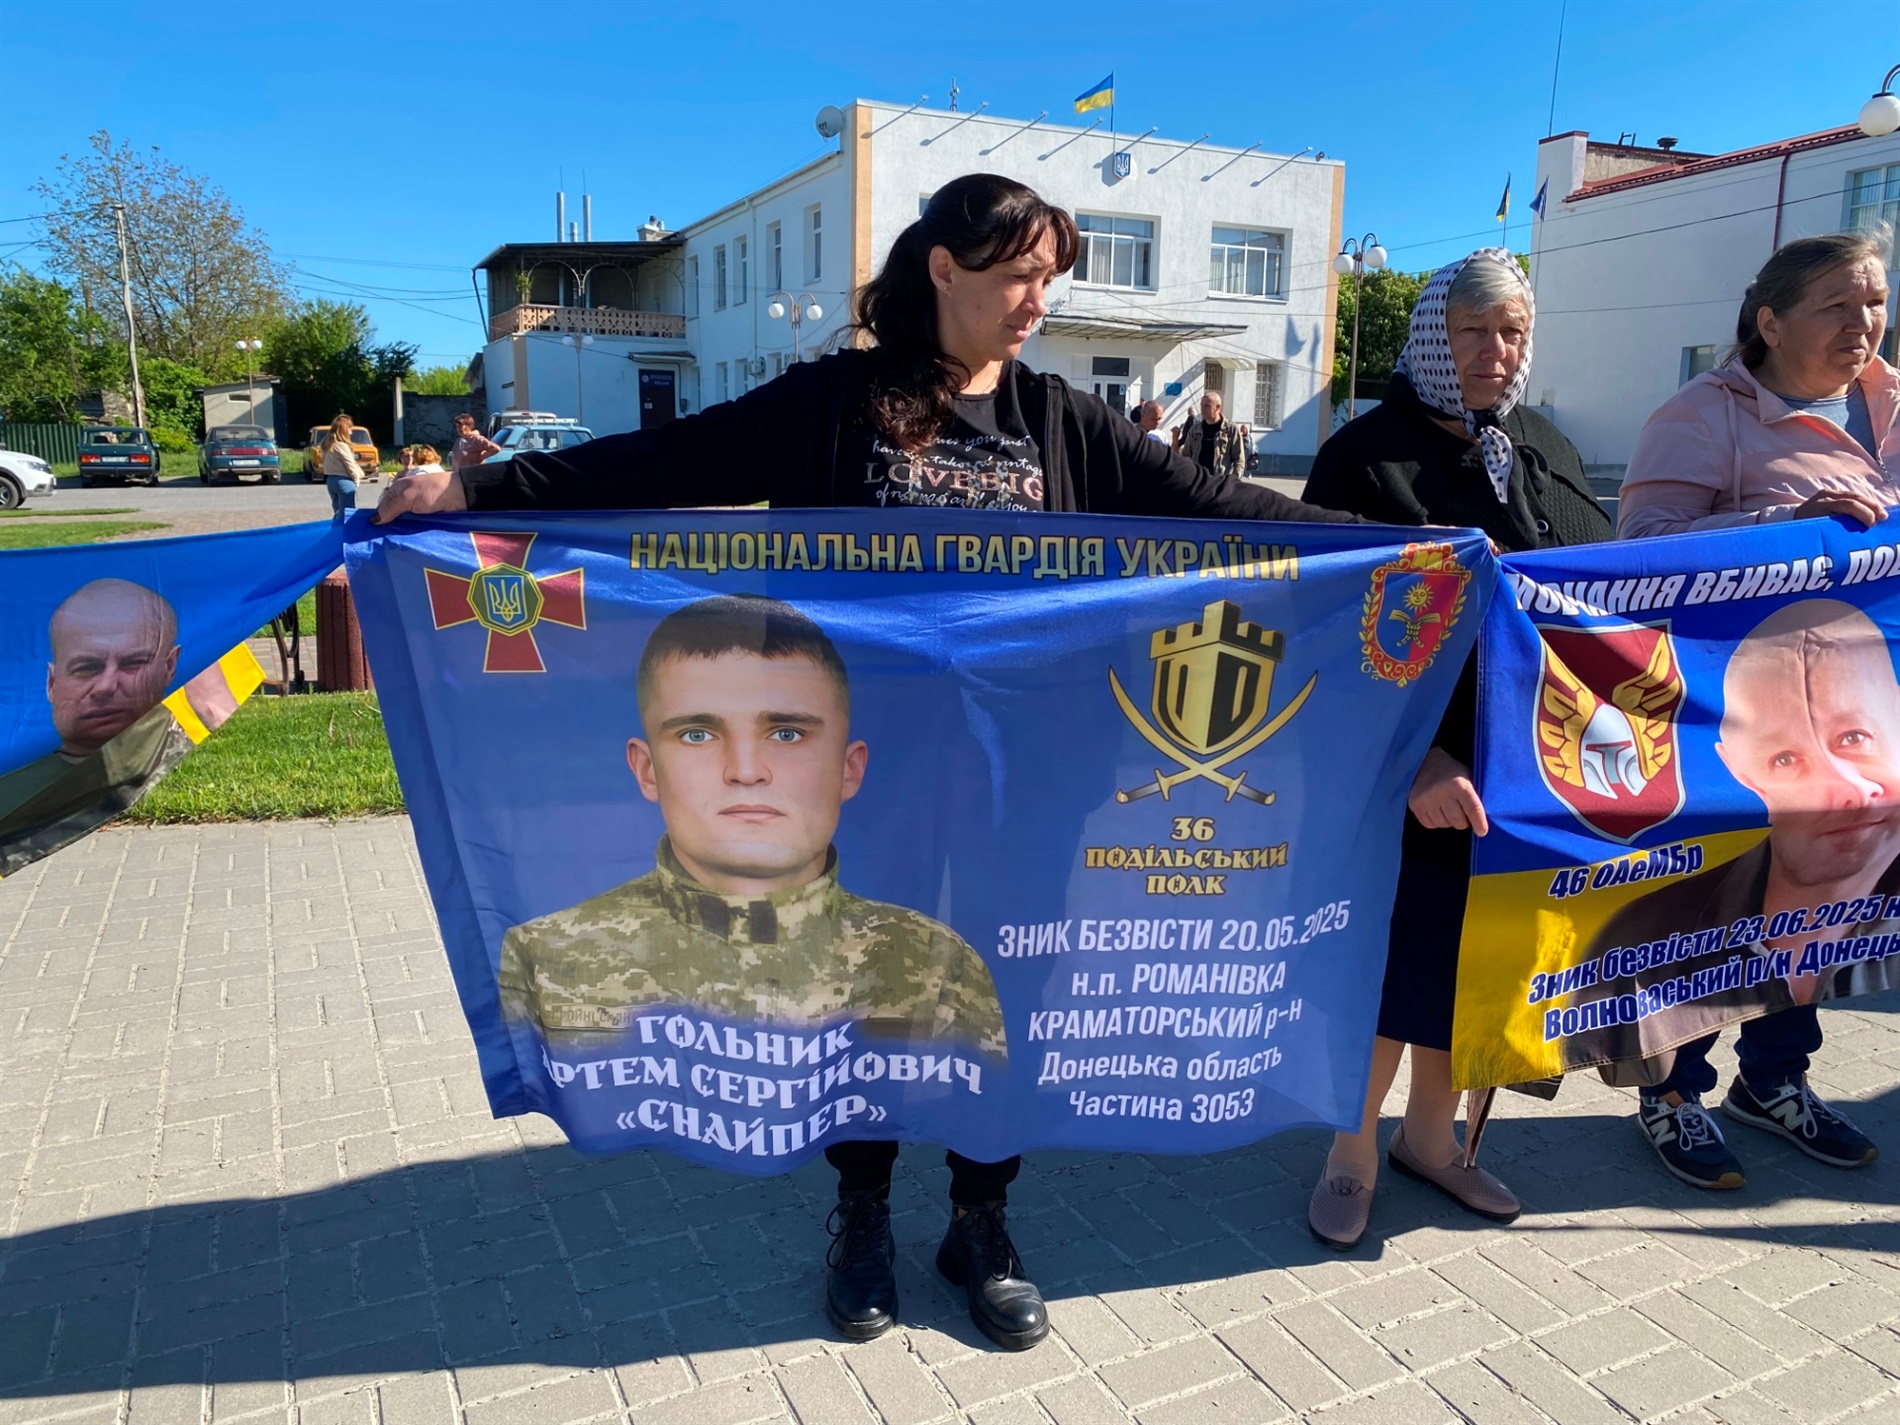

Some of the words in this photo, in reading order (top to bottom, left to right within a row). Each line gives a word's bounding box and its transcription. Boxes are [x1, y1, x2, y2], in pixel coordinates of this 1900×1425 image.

[630, 532, 924, 575] НАЦІОНАЛЬНА
[934, 533, 1106, 581] ГВАРДІЯ
[1115, 534, 1301, 582] УКРАЇНИ
[1683, 555, 1835, 604] ВБИВАЄ,
[1170, 816, 1215, 842] 36
[1085, 843, 1289, 871] ПОДІЛЬСЬКИЙ
[1548, 863, 1591, 900] 46
[1590, 843, 1704, 890] ОАеМБр
[1146, 873, 1227, 896] ПОЛК
[997, 919, 1072, 958] ЗНИК
[1078, 919, 1213, 952] БЕЗВІСТИ
[1219, 900, 1351, 952] 20.05.2025
[1527, 958, 1599, 1005] Зник
[1601, 926, 1727, 983] безвісти
[1729, 894, 1886, 949] 23.06.2025
[1131, 961, 1287, 996] РОМАНІВКА
[1543, 952, 1743, 1043] Волноваський
[1744, 948, 1792, 989] р/н
[636, 1014, 854, 1069] ГОЛЬНИК
[1028, 1002, 1264, 1042] КРАМАТОРСЬКИЙ
[1263, 998, 1303, 1040] р-н
[690, 1051, 982, 1112] СЕРГІЙОВИЧ
[1038, 1052, 1178, 1085] Донецька
[1186, 1046, 1282, 1082] область
[616, 1094, 887, 1157] «СНАЙПЕР»
[1069, 1091, 1183, 1121] Частина
[1190, 1088, 1255, 1123] 3053
